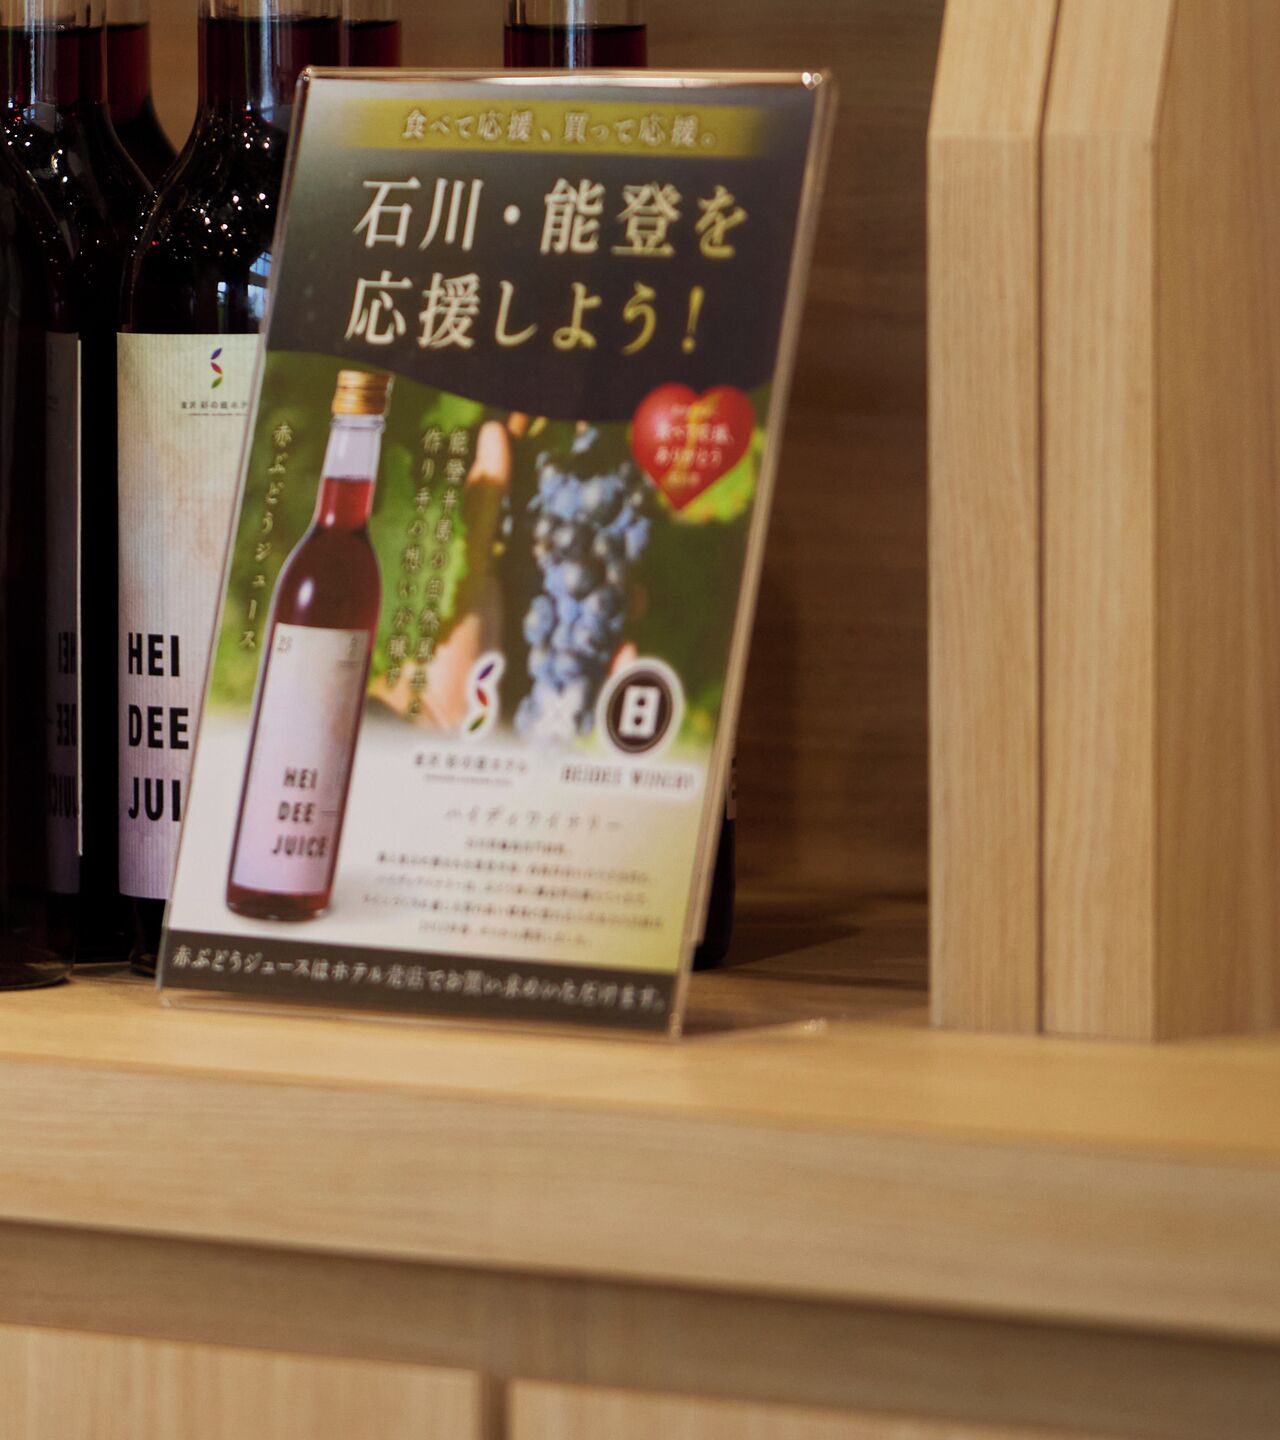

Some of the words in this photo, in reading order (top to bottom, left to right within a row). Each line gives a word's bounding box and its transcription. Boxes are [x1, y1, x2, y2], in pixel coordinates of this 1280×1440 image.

[402, 109, 717, 148] 食べて応援、買って応援。
[352, 176, 748, 258] 石川・能登を
[239, 422, 293, 650] 赤ぶどうジュース
[128, 631, 181, 677] HEI
[127, 703, 190, 750] DEE
[128, 776, 182, 822] JUI
[282, 767, 319, 790] HEI
[276, 800, 316, 824] DEE
[270, 833, 329, 858] JUICE
